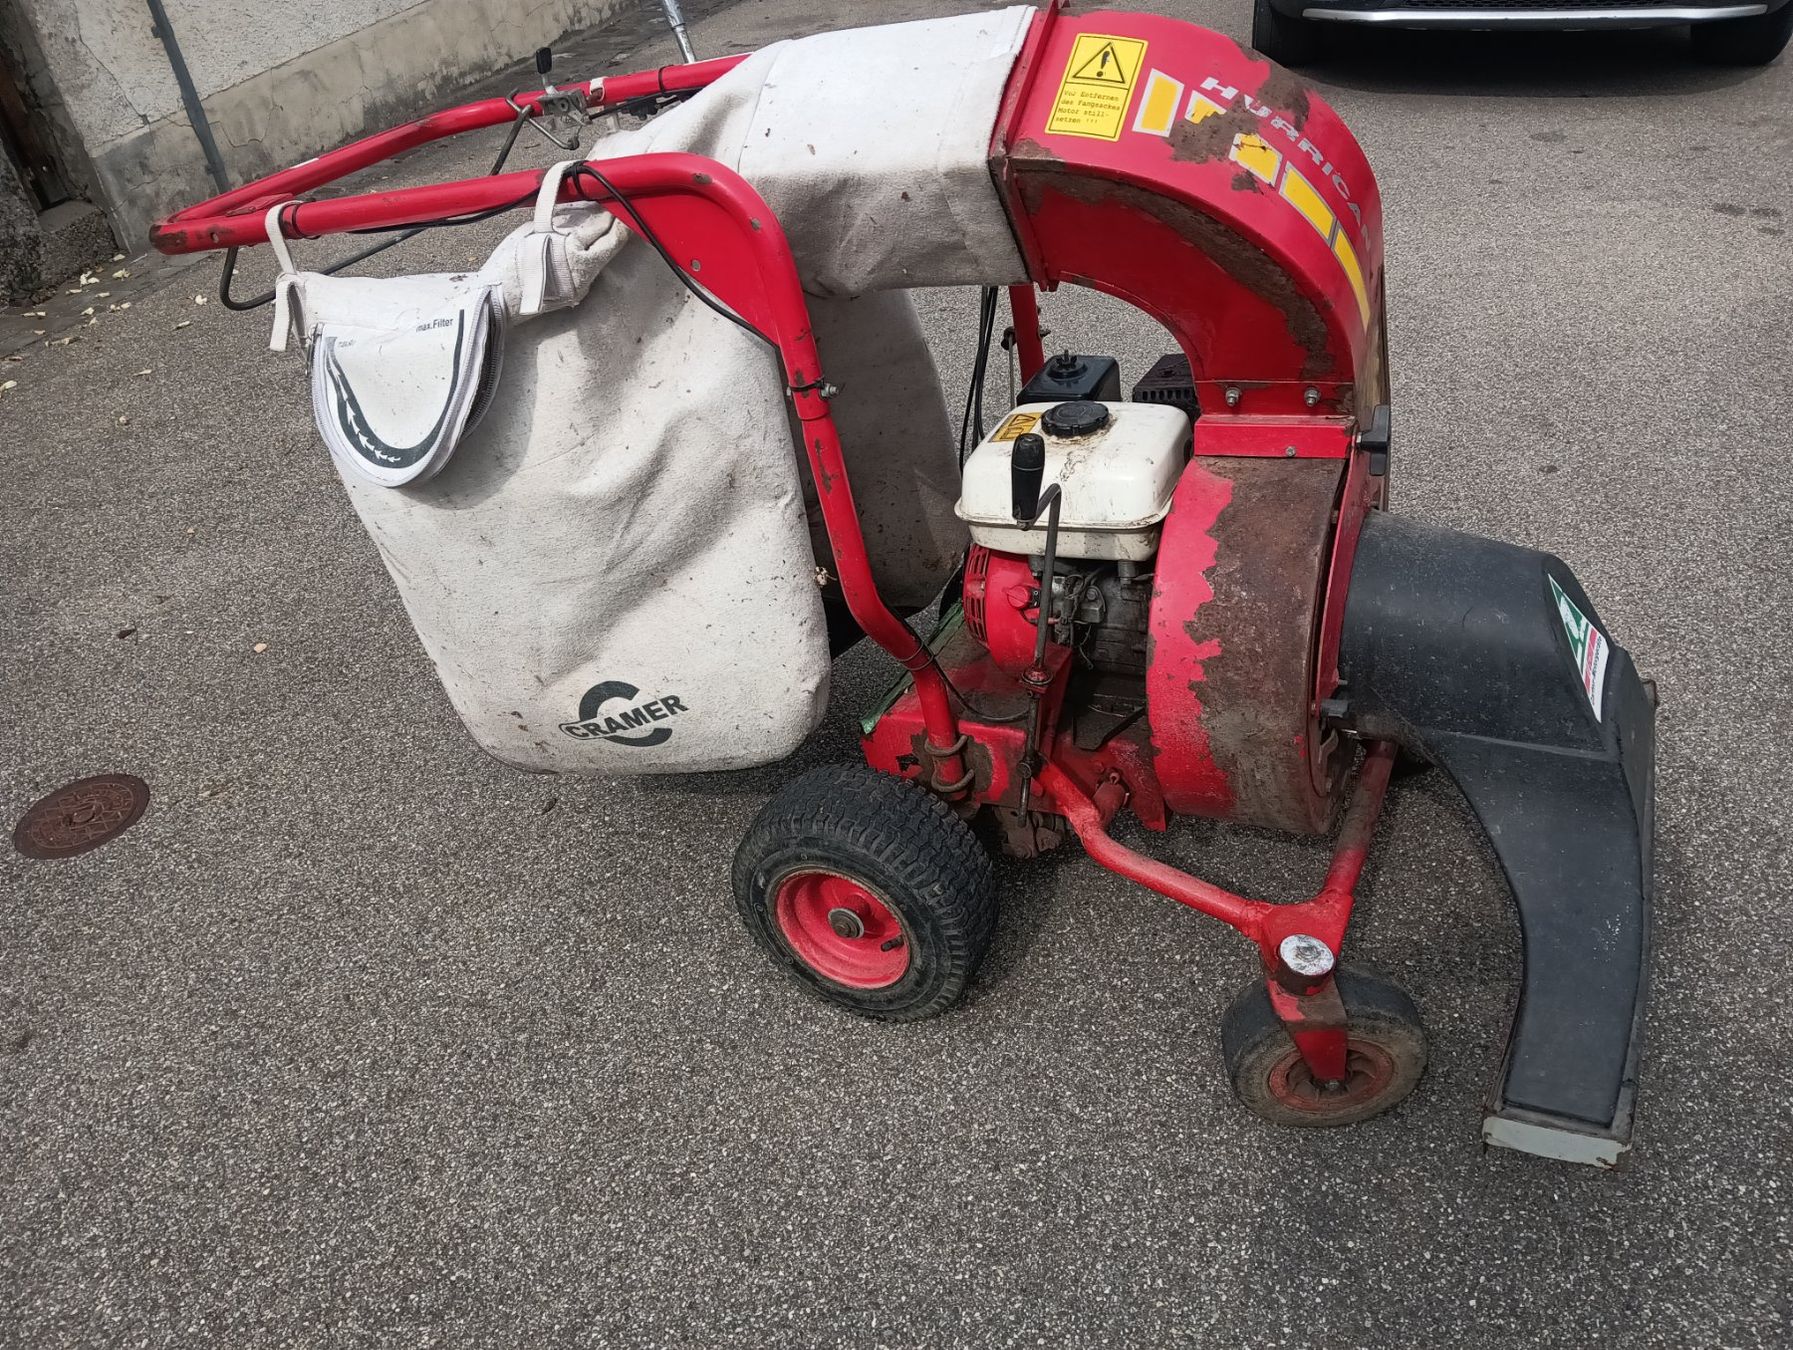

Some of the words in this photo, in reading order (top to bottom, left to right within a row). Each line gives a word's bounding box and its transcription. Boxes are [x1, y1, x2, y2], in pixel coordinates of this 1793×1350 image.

[1080, 91, 1119, 101] Entfernen
[1077, 100, 1121, 111] Fangsackes
[1057, 107, 1080, 115] Motor
[1055, 116, 1081, 124] setzen
[415, 317, 454, 333] max.Filter
[565, 694, 690, 738] CRAMER
